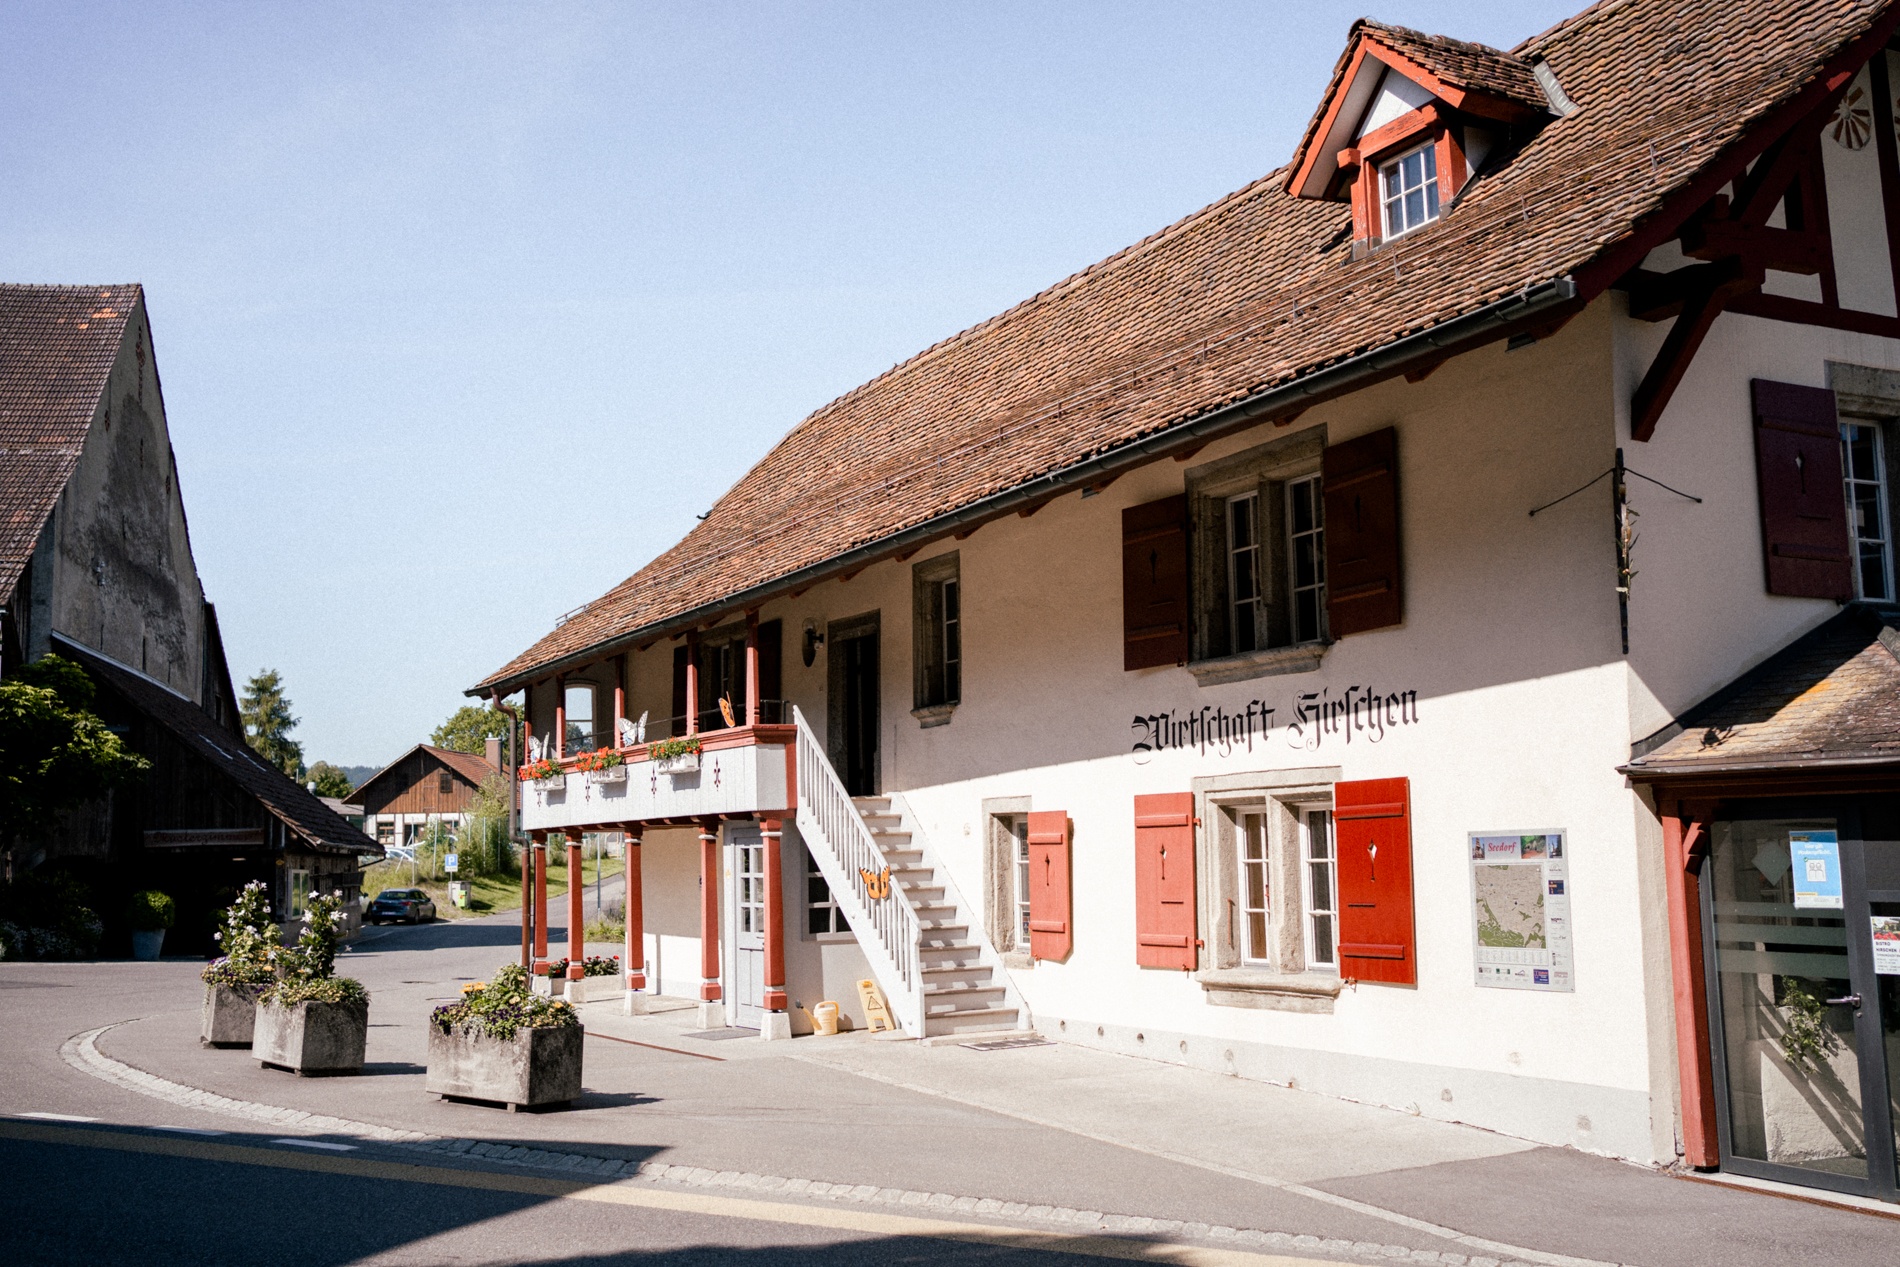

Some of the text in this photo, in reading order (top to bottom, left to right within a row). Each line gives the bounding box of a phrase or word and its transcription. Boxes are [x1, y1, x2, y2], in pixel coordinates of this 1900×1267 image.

[1286, 686, 1419, 752] Hirschen
[1488, 842, 1516, 853] Seedorf
[448, 856, 454, 865] P
